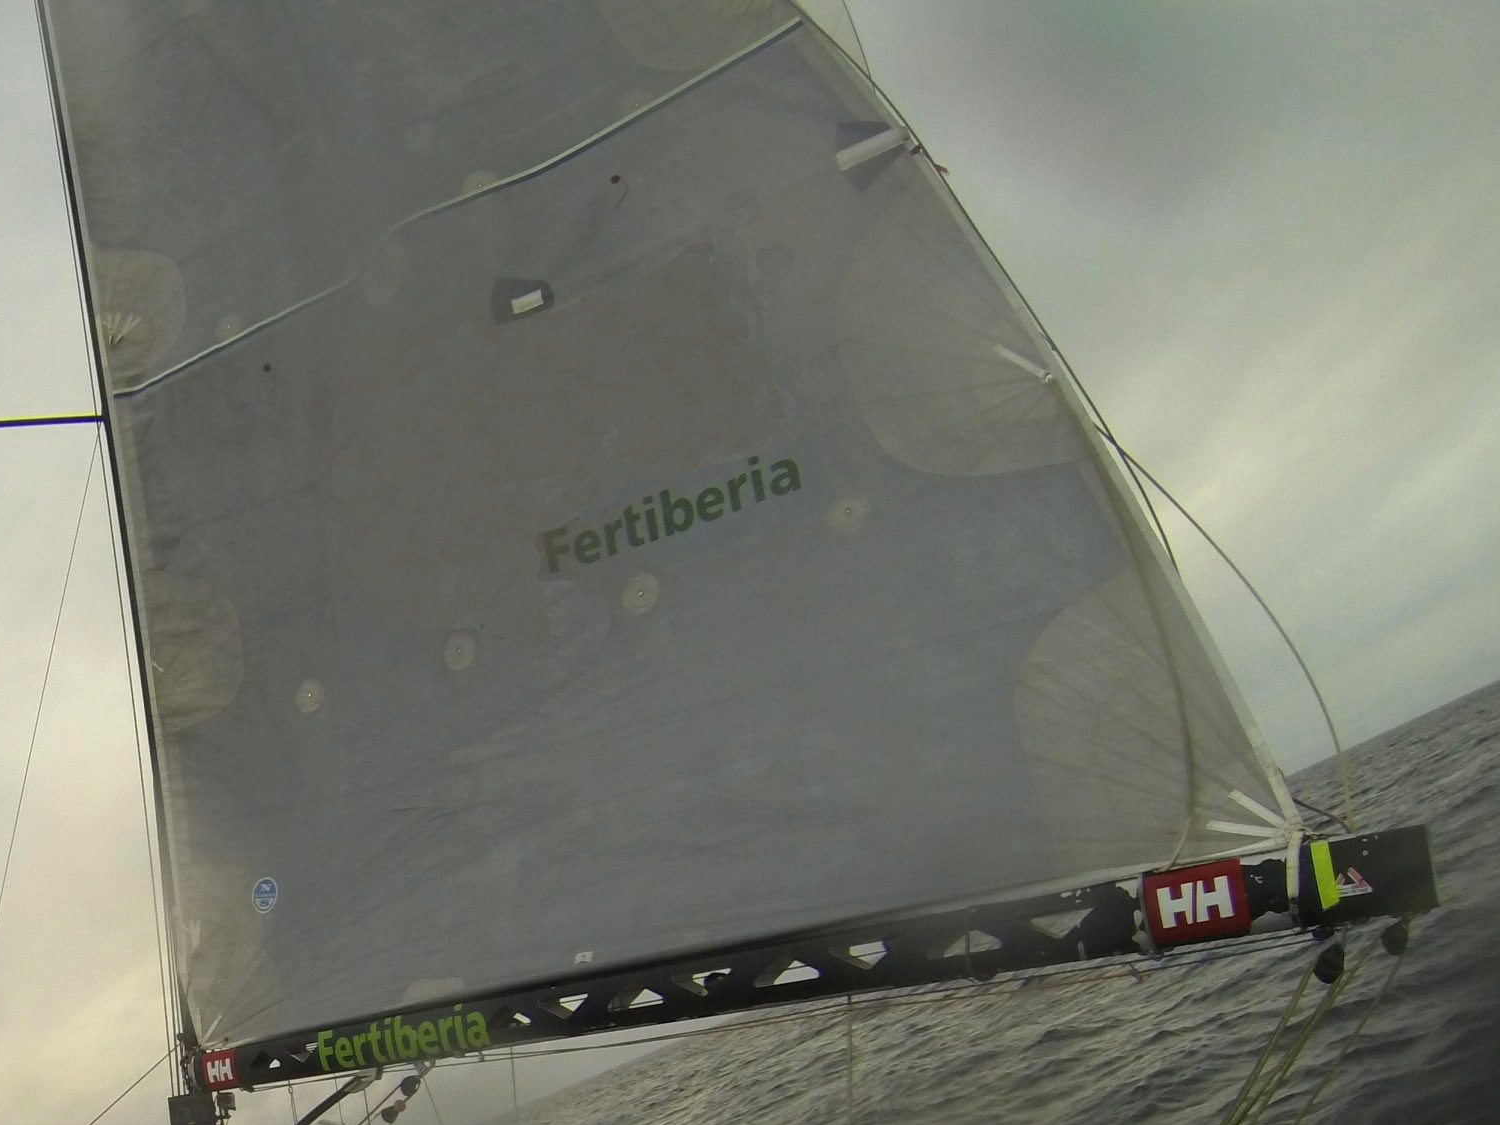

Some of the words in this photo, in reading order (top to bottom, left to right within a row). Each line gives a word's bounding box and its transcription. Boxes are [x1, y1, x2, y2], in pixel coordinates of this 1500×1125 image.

[540, 455, 802, 575] Fertiberia
[1155, 875, 1235, 929] HH
[317, 1003, 491, 1072] Fertiberia
[206, 1057, 235, 1084] HH
